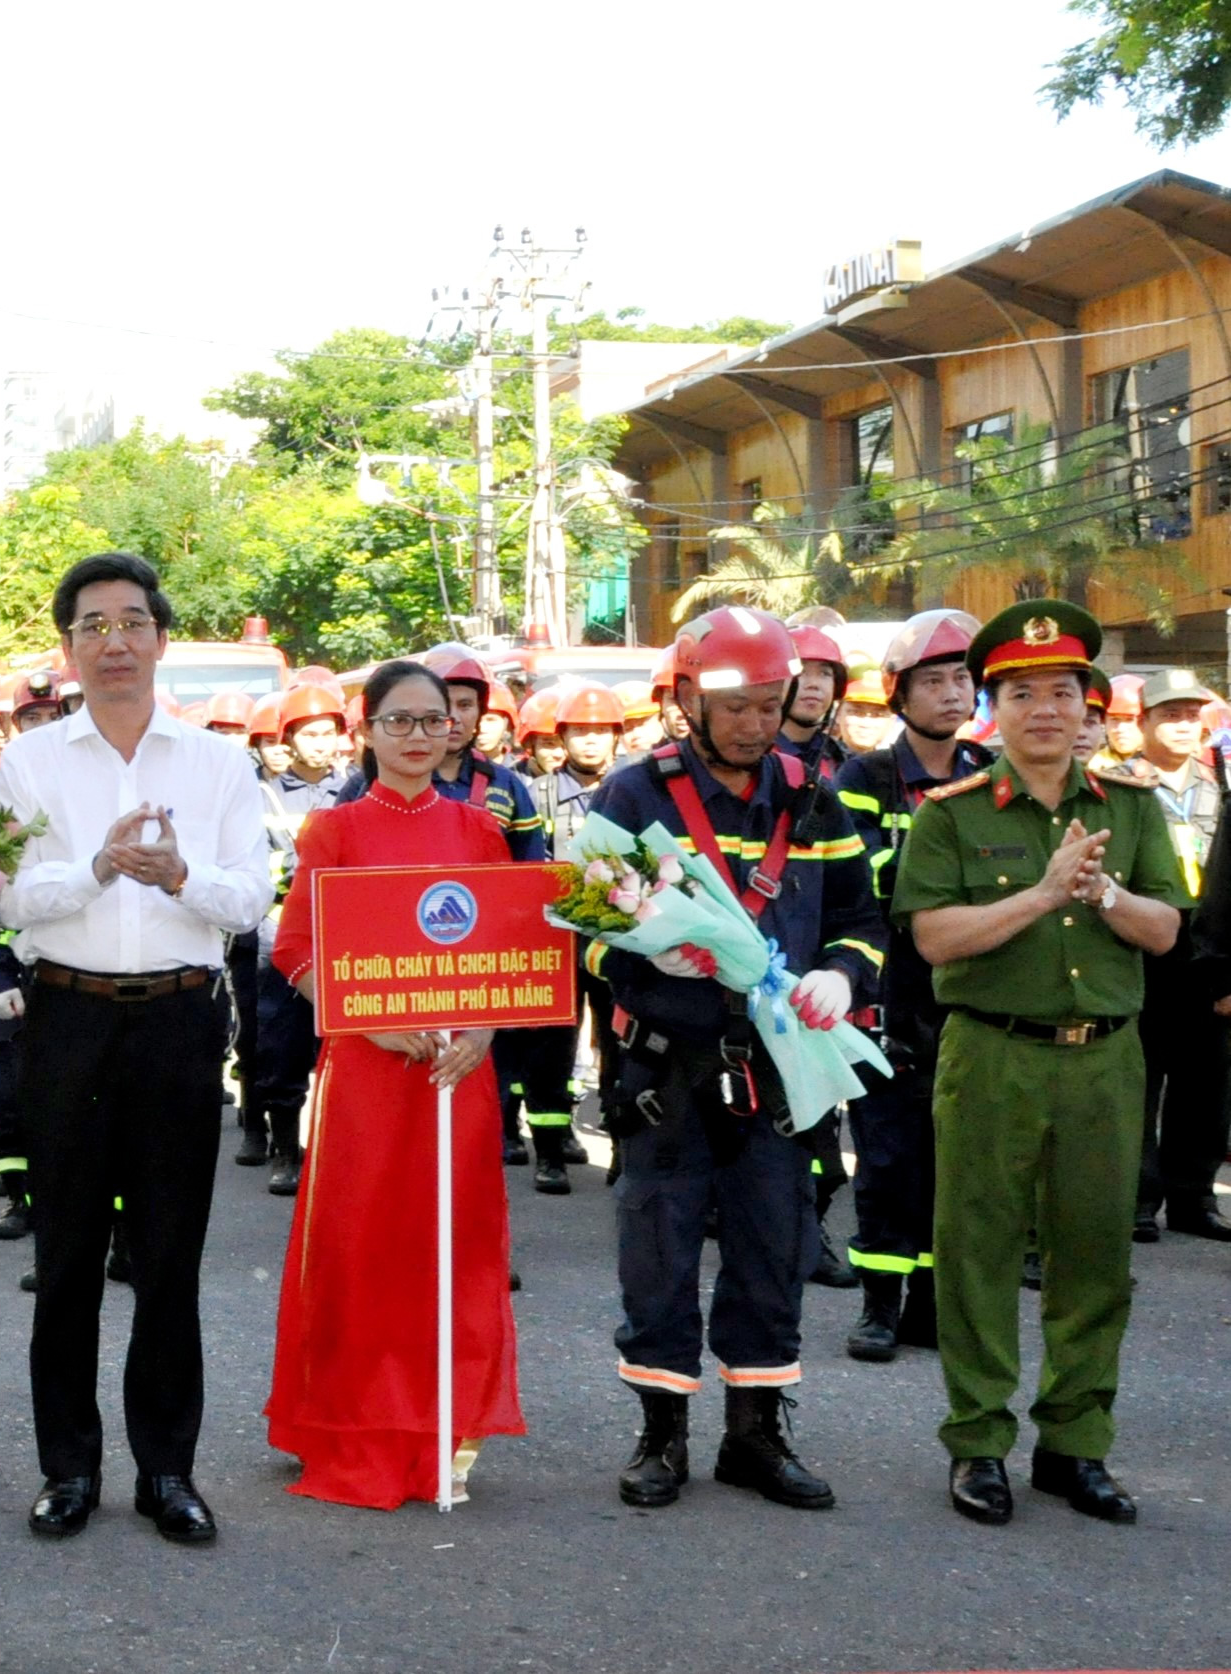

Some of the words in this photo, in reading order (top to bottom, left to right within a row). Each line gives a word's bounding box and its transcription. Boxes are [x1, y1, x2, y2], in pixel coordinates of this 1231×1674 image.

[332, 952, 351, 981] TỔ
[354, 954, 391, 980] CHỮA
[396, 953, 432, 978] CHÁY
[436, 951, 454, 976] VÀ
[458, 953, 496, 974] CNCH
[500, 948, 528, 976] ĐẶC
[532, 946, 562, 975] BIỆT
[344, 991, 382, 1017] CÔNG
[386, 994, 405, 1015] AN
[410, 988, 455, 1013] THÀNH
[459, 982, 487, 1010] PHỐ
[491, 984, 509, 1008] ĐÀ
[514, 979, 552, 1007] NẴNG
